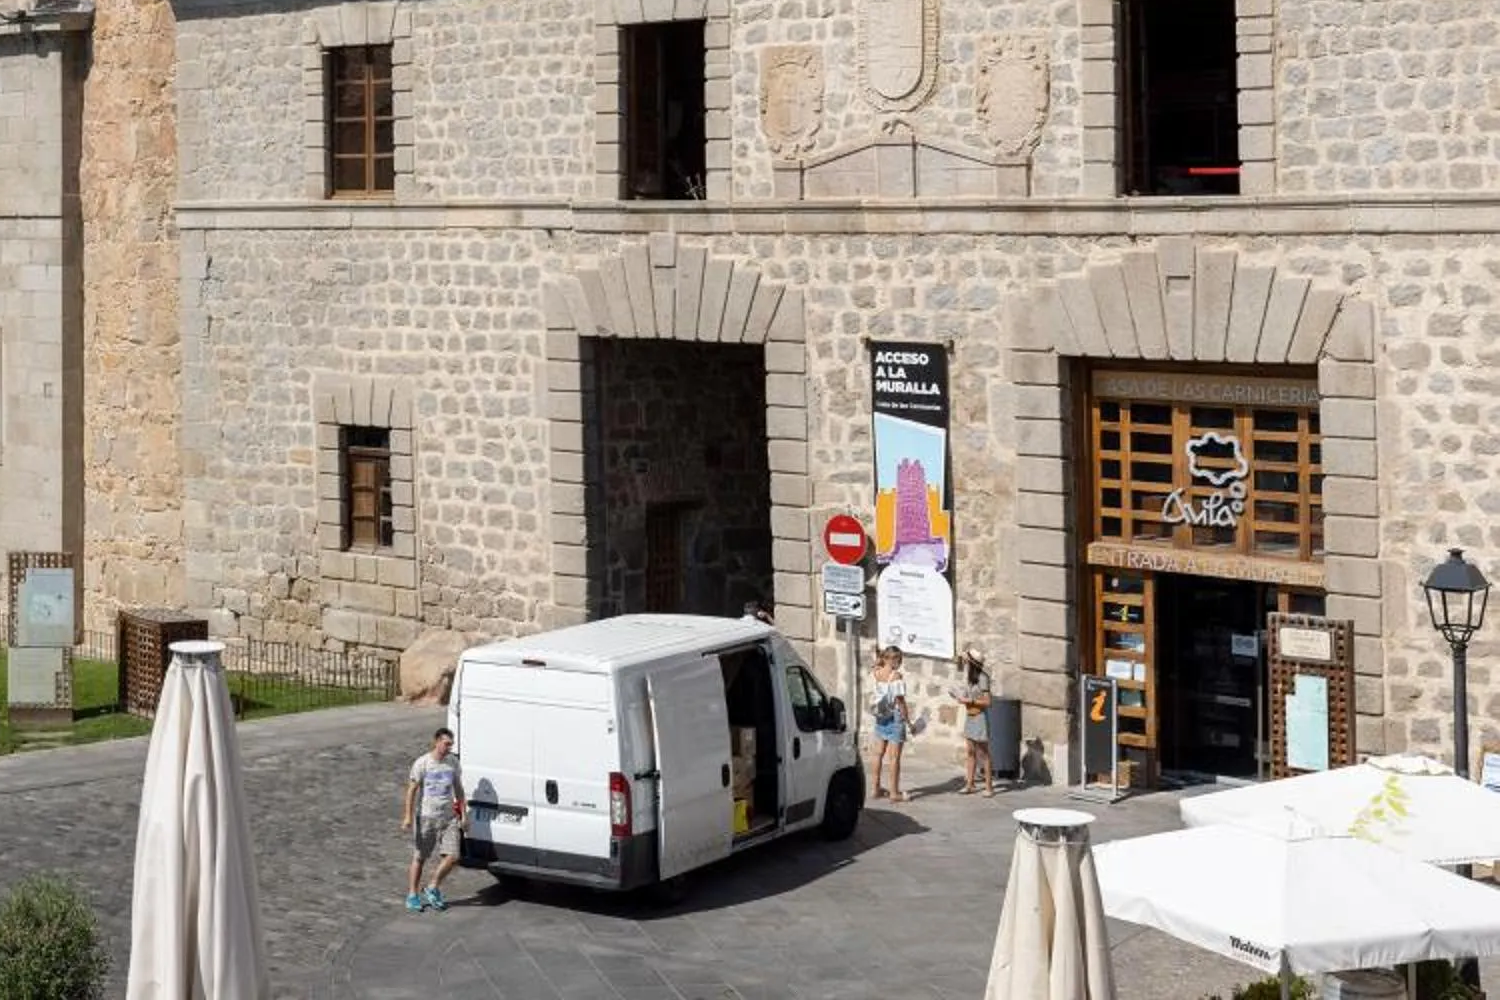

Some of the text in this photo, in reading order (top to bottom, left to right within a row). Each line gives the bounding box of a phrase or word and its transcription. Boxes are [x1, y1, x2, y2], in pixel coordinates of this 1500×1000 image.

[875, 351, 929, 365] ACCESO
[875, 366, 907, 379] A LA
[875, 380, 941, 395] MURALLA
